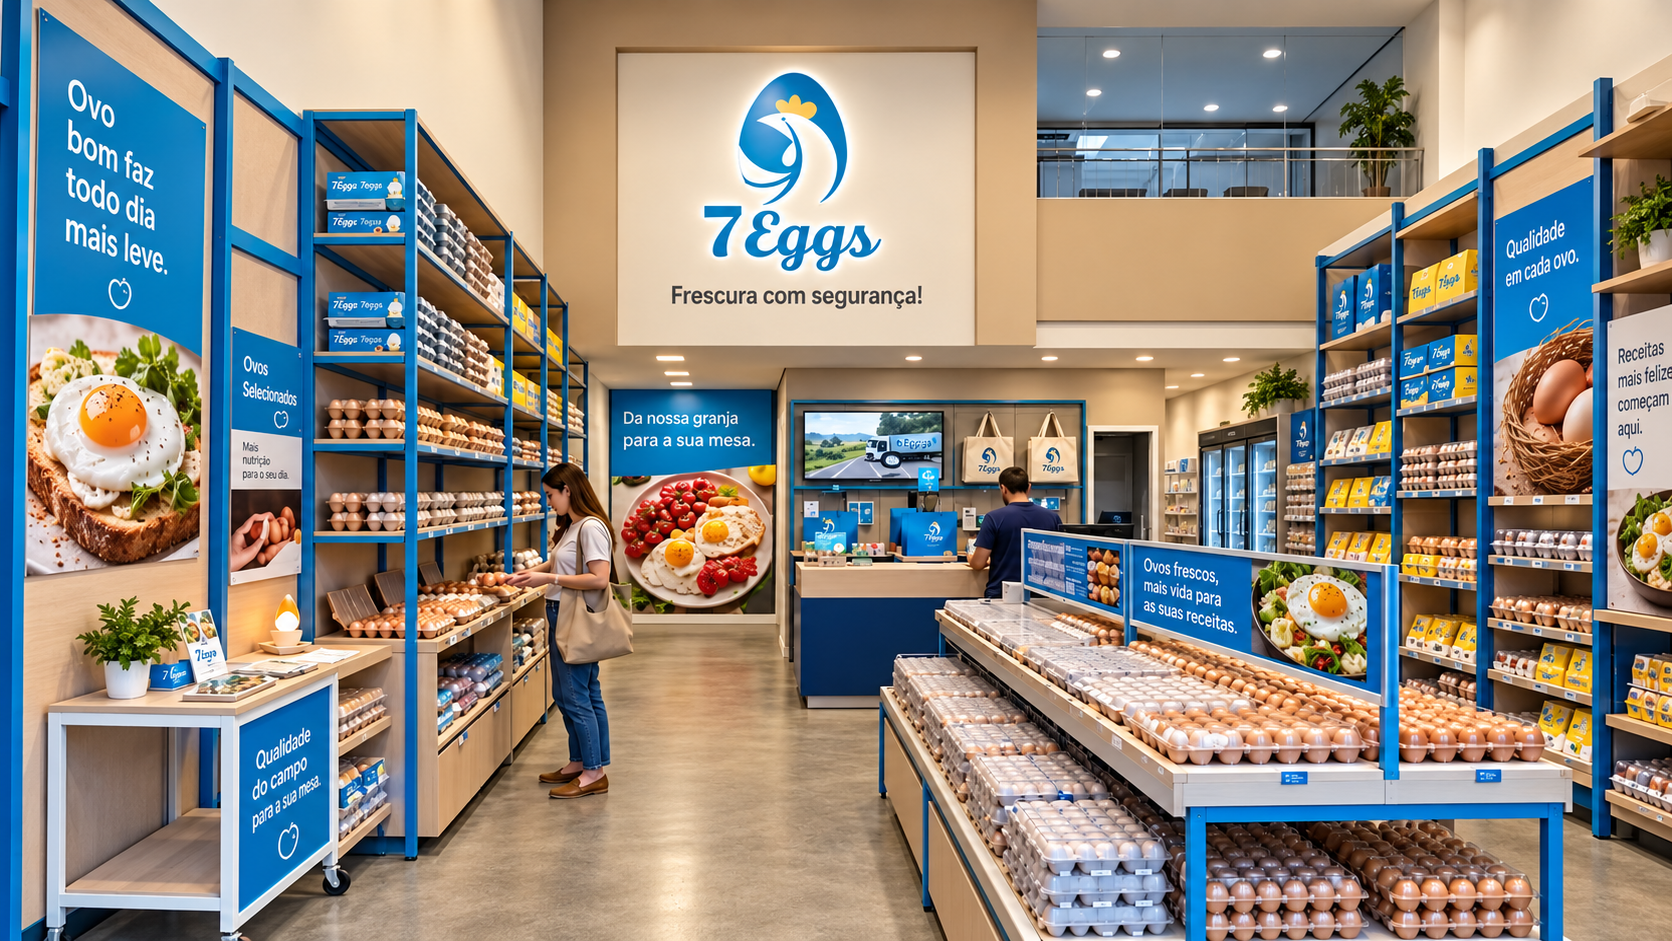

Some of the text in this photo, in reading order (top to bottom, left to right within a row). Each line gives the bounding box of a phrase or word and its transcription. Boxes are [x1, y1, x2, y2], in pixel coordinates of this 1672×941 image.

[67, 78, 115, 128] Ovo
[67, 119, 154, 190] bom faz
[66, 167, 155, 231] todo dia
[65, 218, 168, 275] mais leve.
[1506, 219, 1565, 259] Qualidade
[1505, 249, 1579, 287] em cada ovo.
[671, 285, 923, 309] Frescura com segurança!
[243, 355, 269, 376] Ovos
[1618, 342, 1665, 364] Receitas
[1618, 364, 1672, 388] mais felize
[242, 380, 298, 406] Selecionados
[1618, 393, 1670, 412] começam
[623, 411, 739, 428] Da nossa granja
[1618, 418, 1643, 440] aqui.
[242, 441, 259, 452] Mais
[623, 436, 755, 450] para a sua mesa.
[242, 470, 258, 481] para
[259, 471, 265, 480] o
[265, 471, 277, 480] seu
[1144, 557, 1219, 586] Ovos frescos,
[1144, 579, 1222, 608] mais vida para
[1144, 599, 1238, 635] as suas receitas.
[255, 727, 311, 770] Qualidade
[252, 757, 308, 801] do campo
[252, 804, 274, 834] para
[275, 800, 281, 814] a
[282, 789, 297, 810] sua
[298, 775, 322, 799] mesa.
